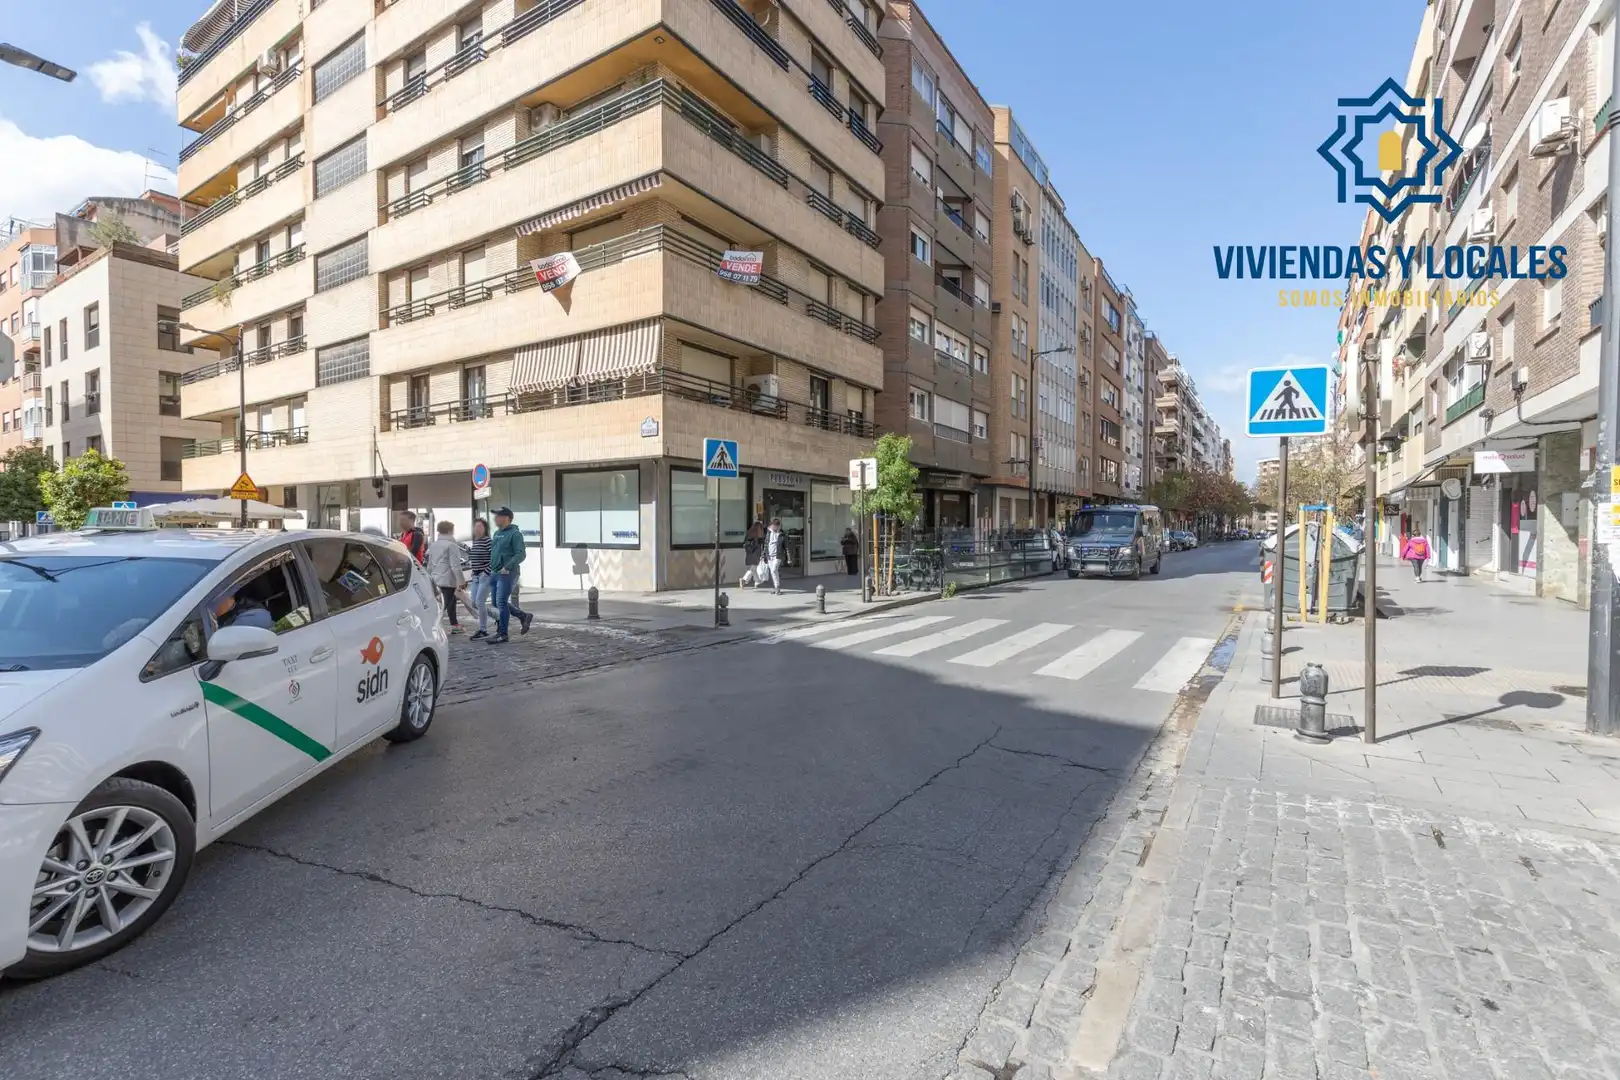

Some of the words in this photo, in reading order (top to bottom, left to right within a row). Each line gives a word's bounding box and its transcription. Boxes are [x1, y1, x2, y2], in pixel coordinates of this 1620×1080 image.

[726, 261, 757, 273] VENDE
[101, 510, 126, 525] TAXI
[357, 665, 388, 704] sidn
